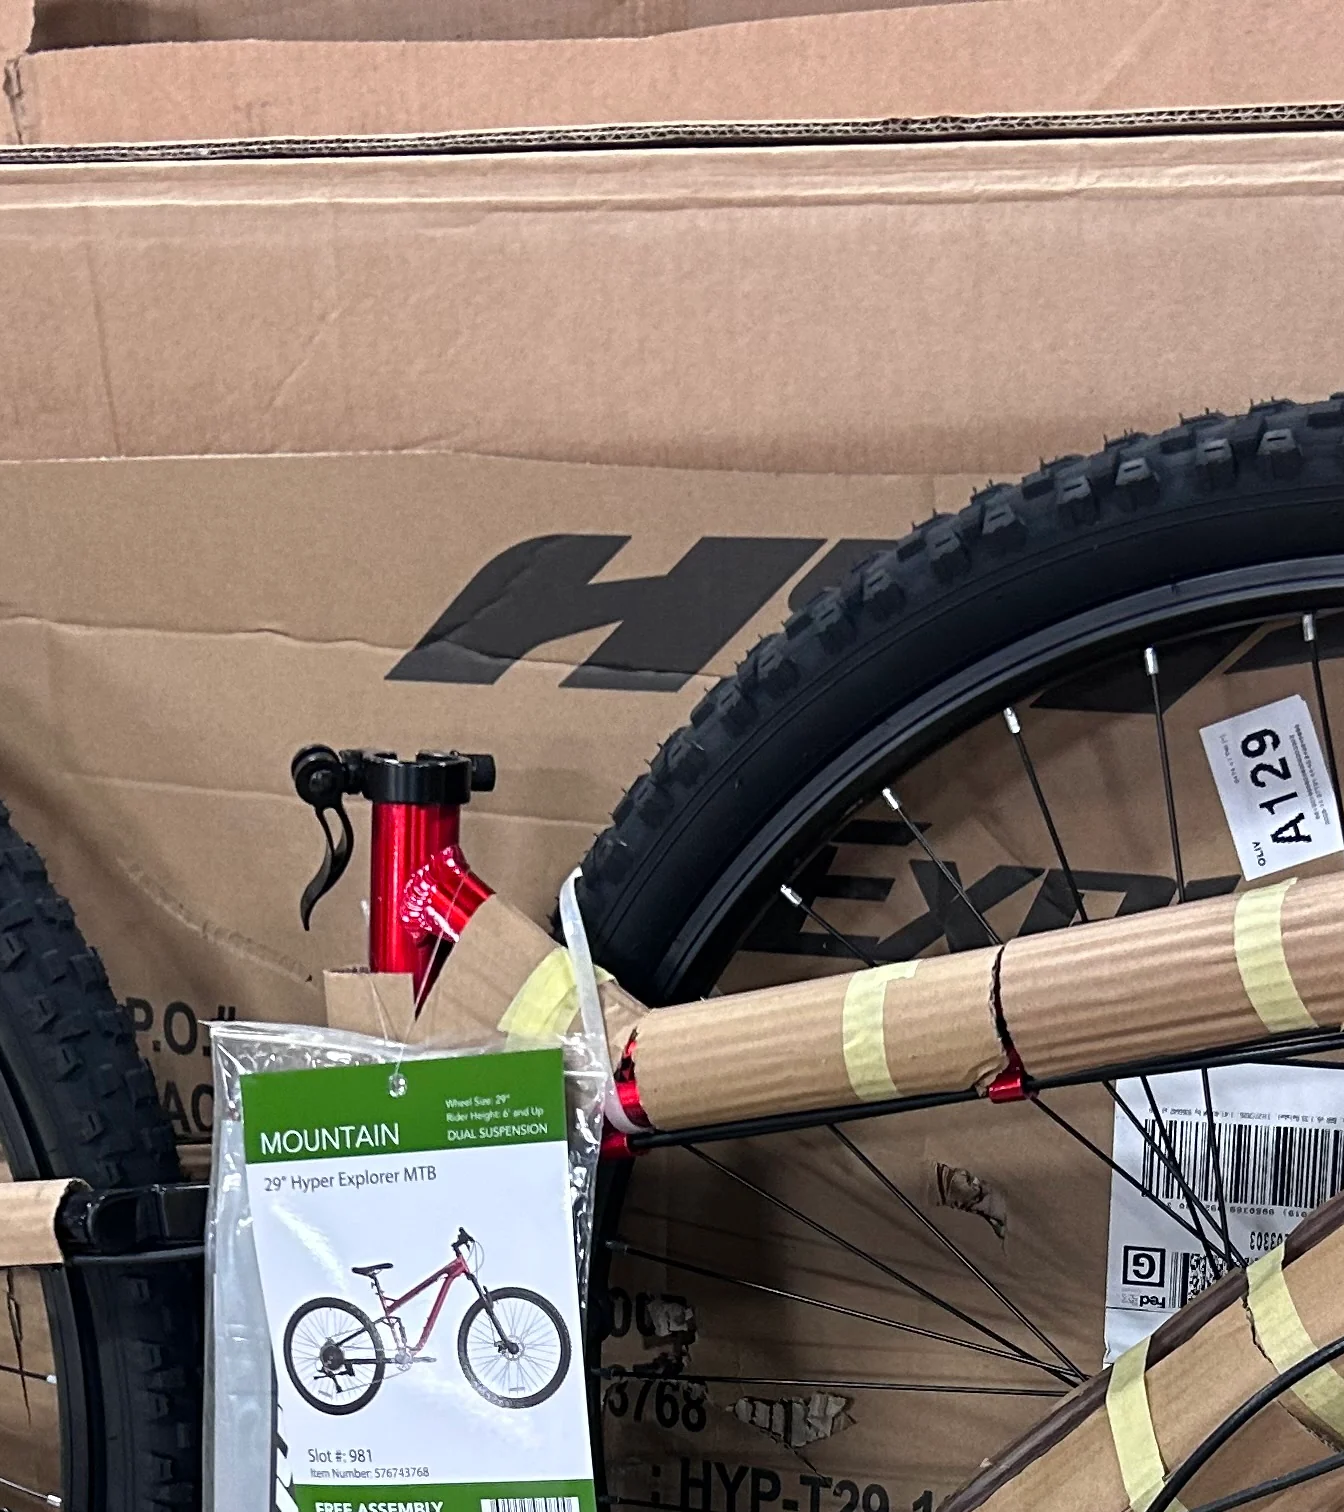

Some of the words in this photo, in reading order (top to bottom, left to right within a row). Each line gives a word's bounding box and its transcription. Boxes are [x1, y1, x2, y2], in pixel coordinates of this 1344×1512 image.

[1241, 729, 1312, 843] A129
[1252, 842, 1266, 866] OLIV
[445, 1098, 473, 1109] Wheel
[446, 1112, 468, 1122] Rider
[513, 1107, 529, 1117] and
[531, 1106, 544, 1118] Up
[260, 1122, 400, 1156] MOUNTAIN
[447, 1128, 476, 1141] DUAL
[479, 1122, 548, 1139] SUSPENSION
[292, 1174, 335, 1194] Hyper
[339, 1169, 400, 1189] Explorer
[404, 1165, 437, 1182] MTB
[1249, 1231, 1289, 1251] 03303
[1132, 1255, 1156, 1276] G
[308, 1449, 333, 1463] Slot
[349, 1449, 372, 1463] 981
[310, 1468, 330, 1479] Item
[332, 1468, 372, 1479] Number:
[375, 1466, 430, 1479] 576743768
